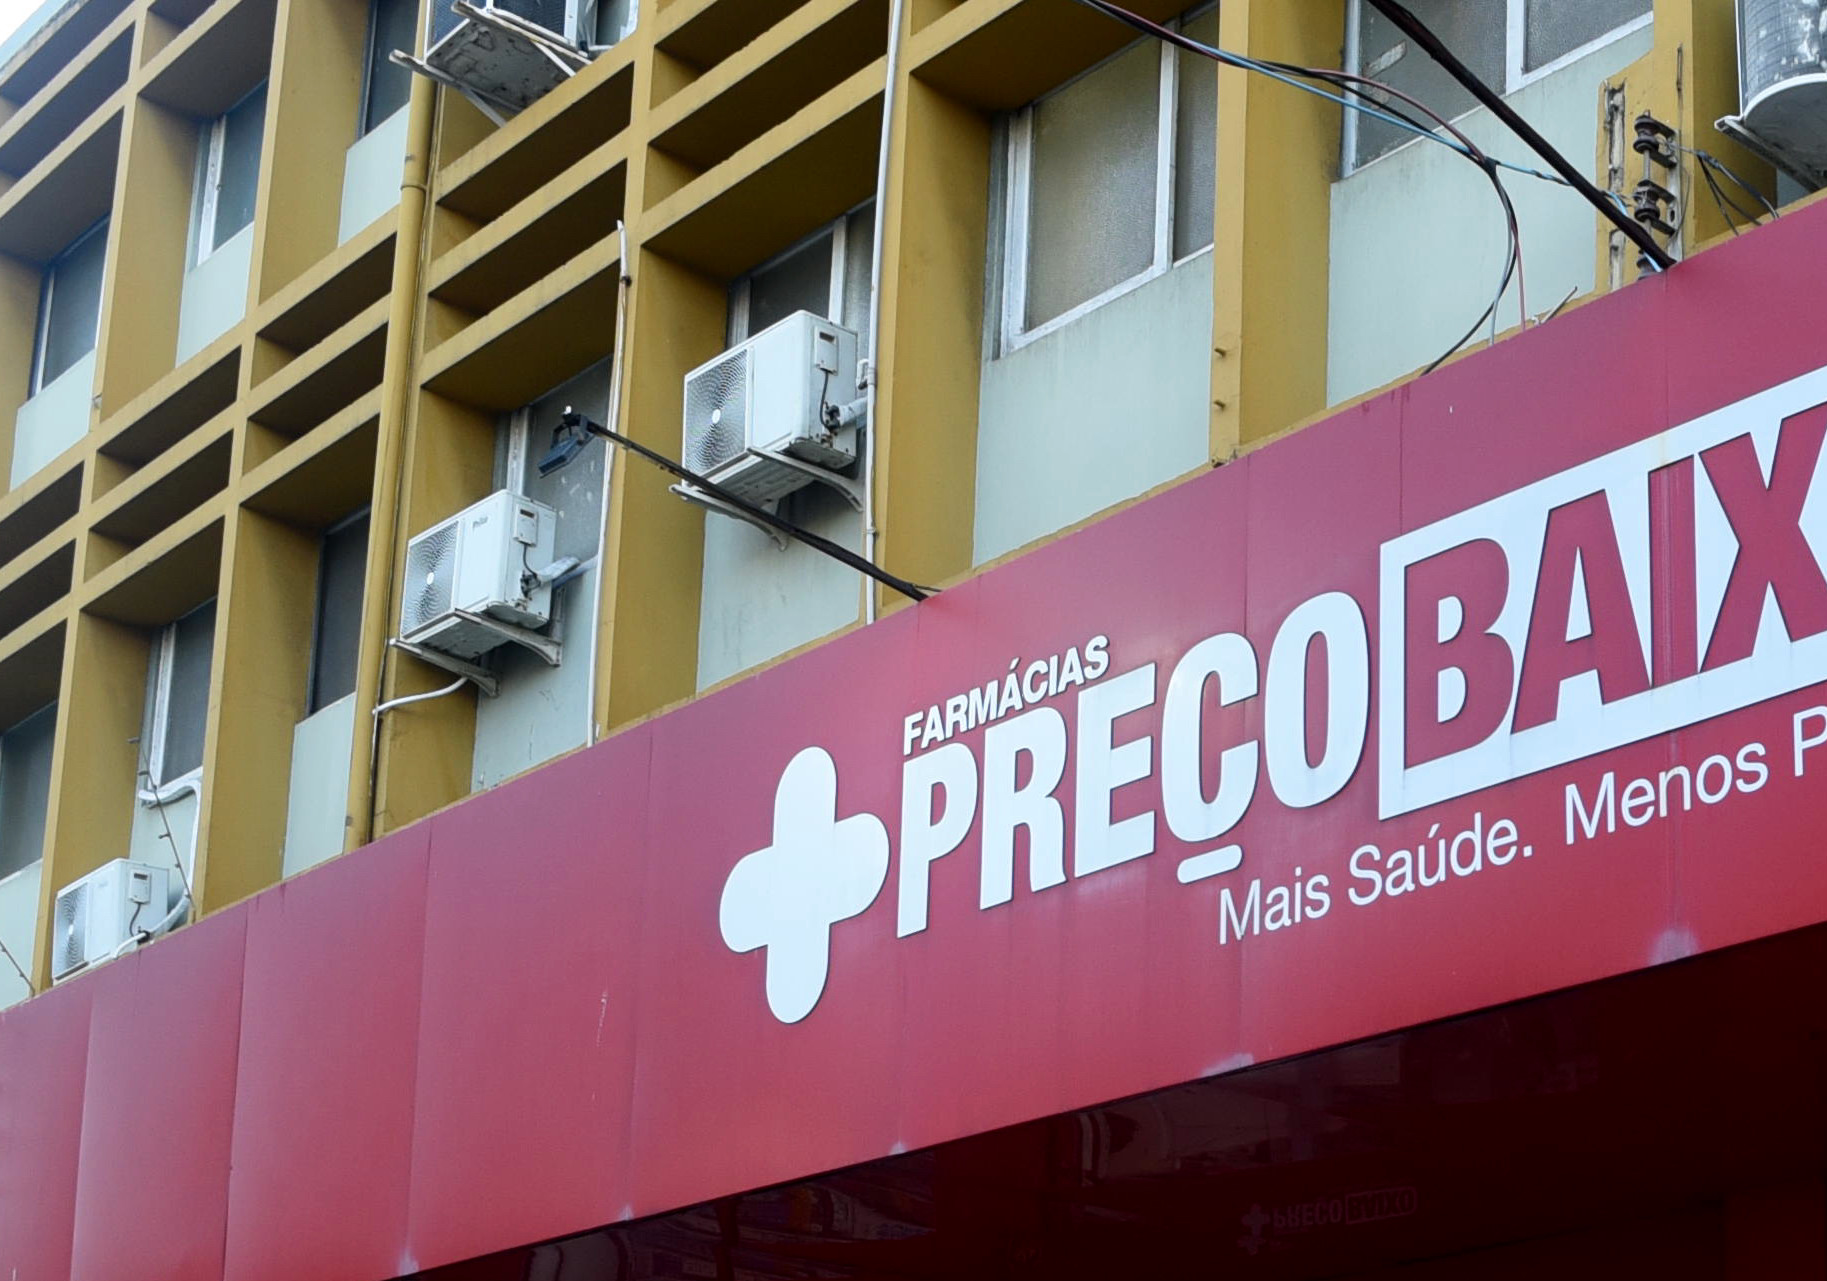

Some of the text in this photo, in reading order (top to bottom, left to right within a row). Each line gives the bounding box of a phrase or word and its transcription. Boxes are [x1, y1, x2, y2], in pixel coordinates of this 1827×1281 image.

[903, 634, 1110, 757] FARMÁCIAS
[1219, 866, 1331, 945] Mais
[1347, 812, 1534, 907] Saúde.
[1562, 741, 1769, 846] Menos
